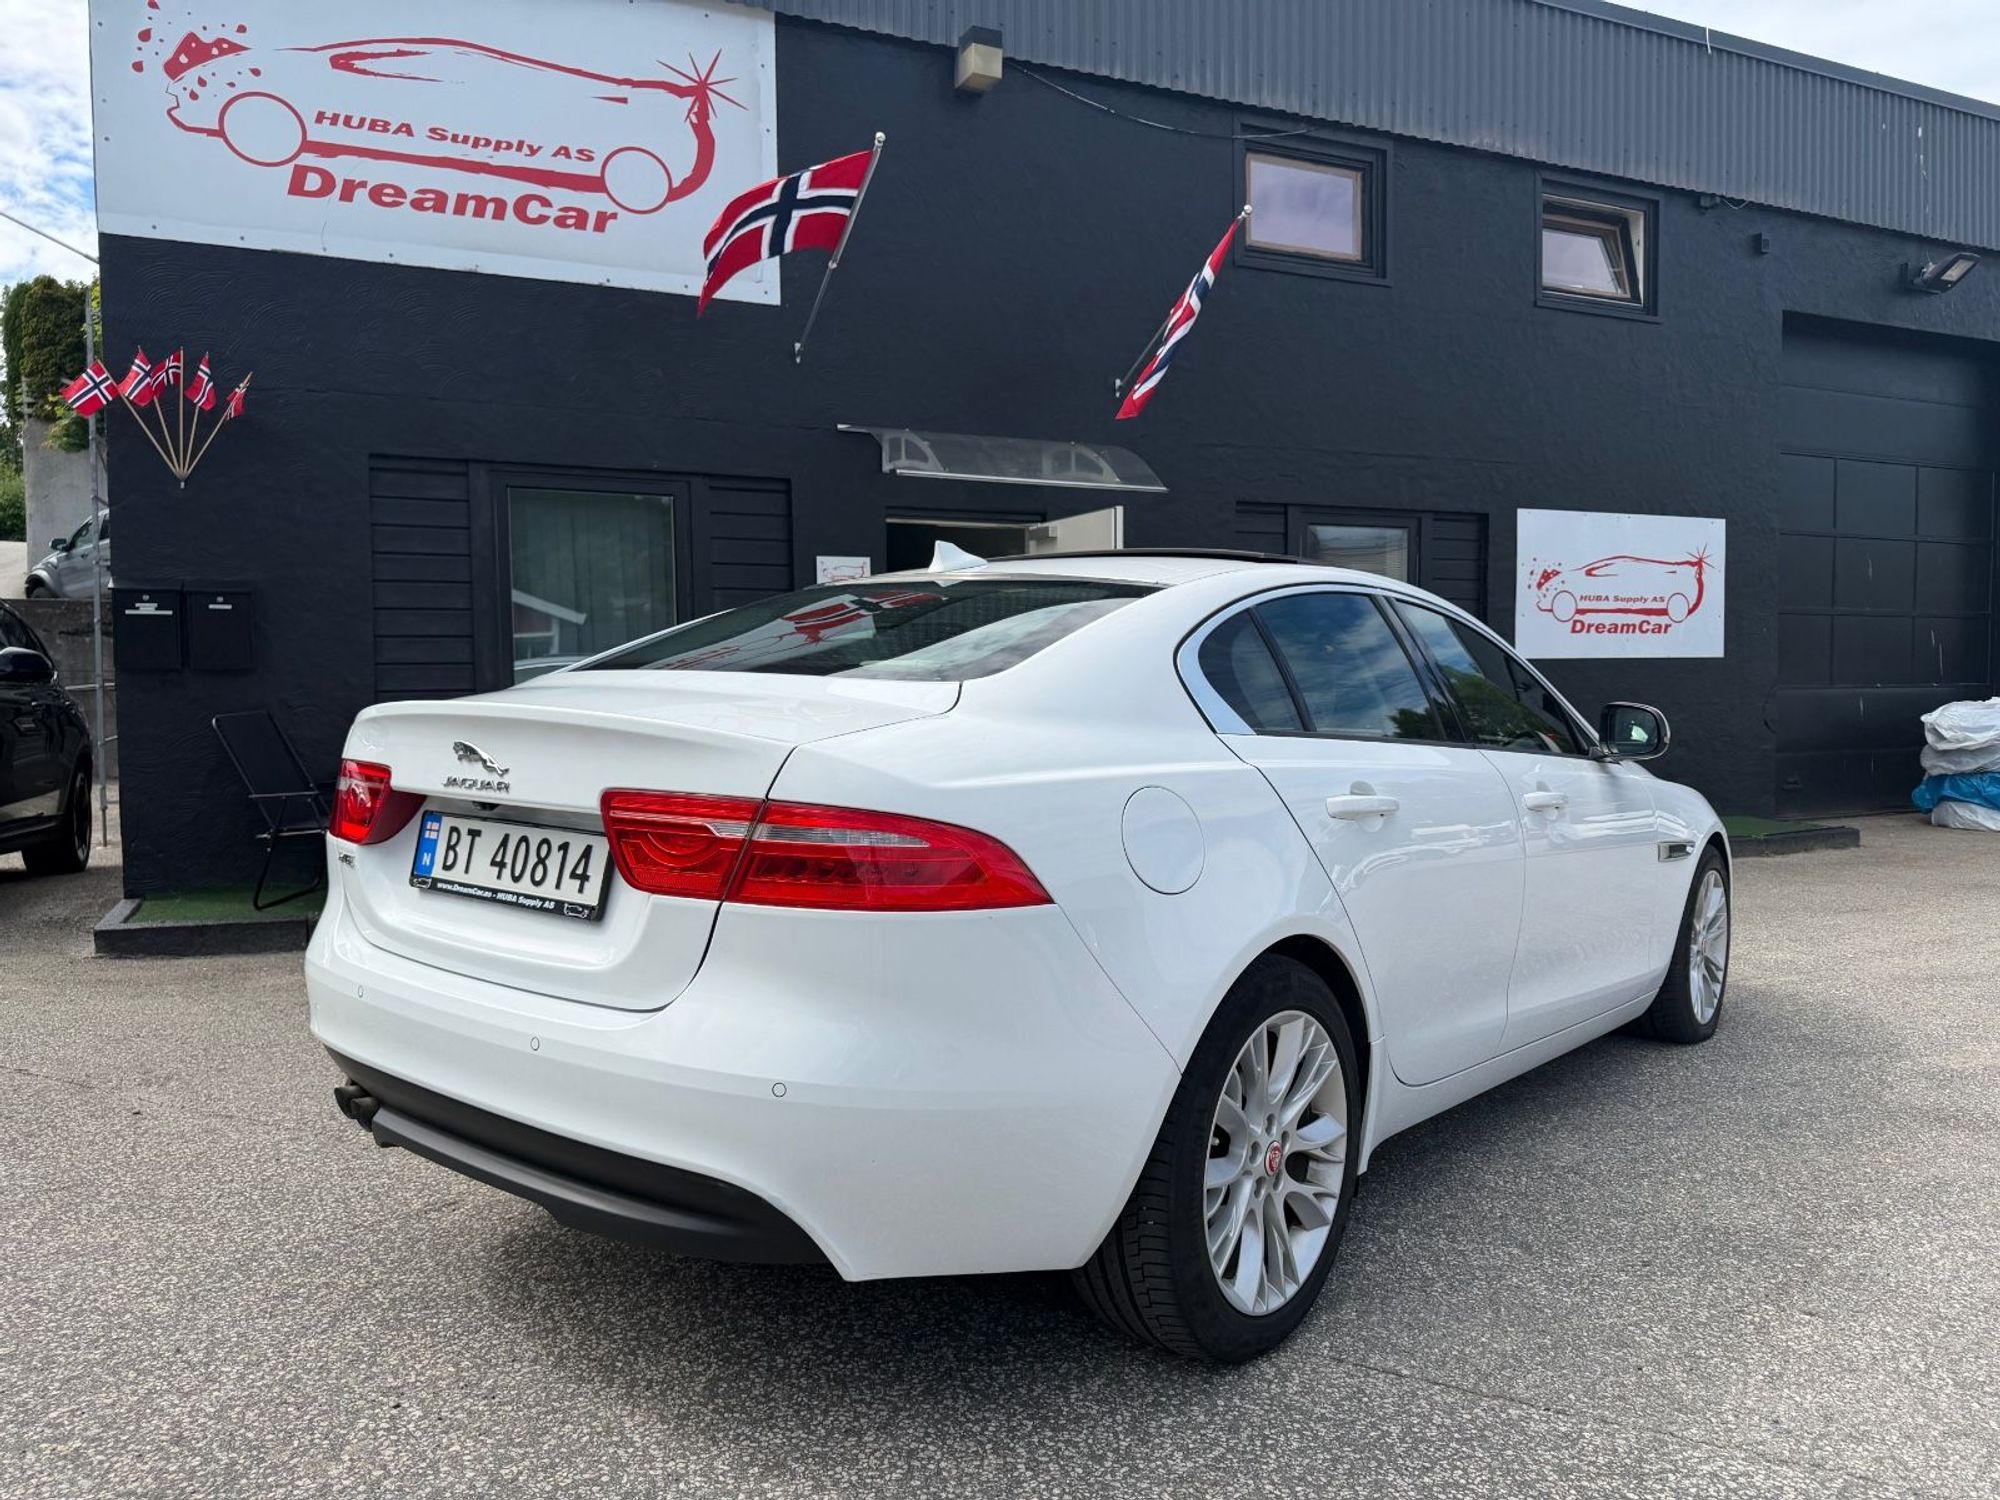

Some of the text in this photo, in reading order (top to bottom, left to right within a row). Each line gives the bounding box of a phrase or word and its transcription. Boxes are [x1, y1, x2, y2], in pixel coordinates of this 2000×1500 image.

[313, 110, 597, 163] HUBA Supply AS
[286, 163, 618, 234] DreamCar
[1579, 594, 1610, 603] HUBA
[1613, 594, 1649, 605] Supply
[1570, 619, 1672, 634] DreamCar
[442, 776, 510, 794] JAGUAR
[421, 852, 431, 867] N
[441, 825, 594, 895] BT 40814
[496, 891, 518, 904] HUBA
[518, 896, 544, 910] Supply
[543, 900, 556, 910] AS
